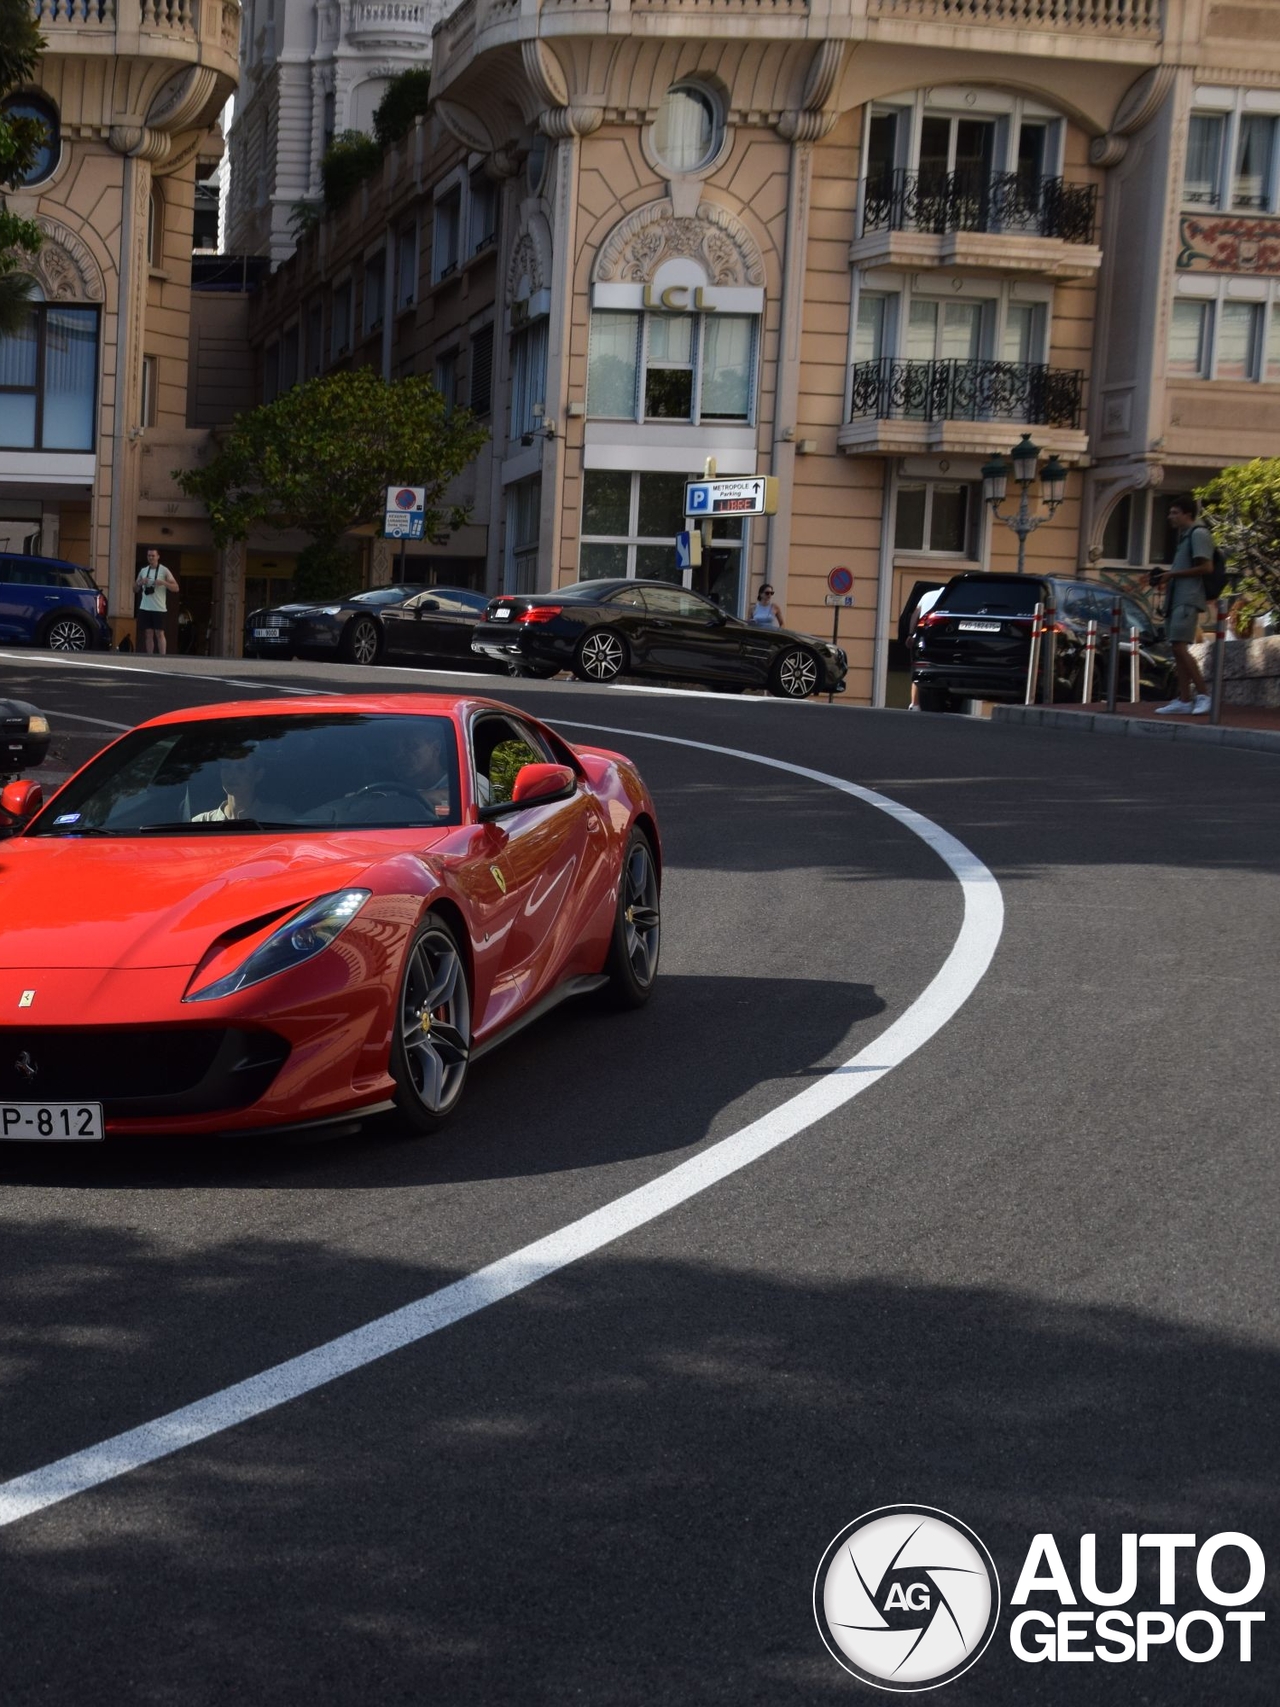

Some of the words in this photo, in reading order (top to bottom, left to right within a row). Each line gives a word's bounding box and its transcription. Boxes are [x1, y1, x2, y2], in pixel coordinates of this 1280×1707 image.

[643, 284, 717, 311] LCL
[713, 483, 749, 491] METROPOLE
[693, 490, 705, 508] P
[720, 499, 752, 511] LIBRE
